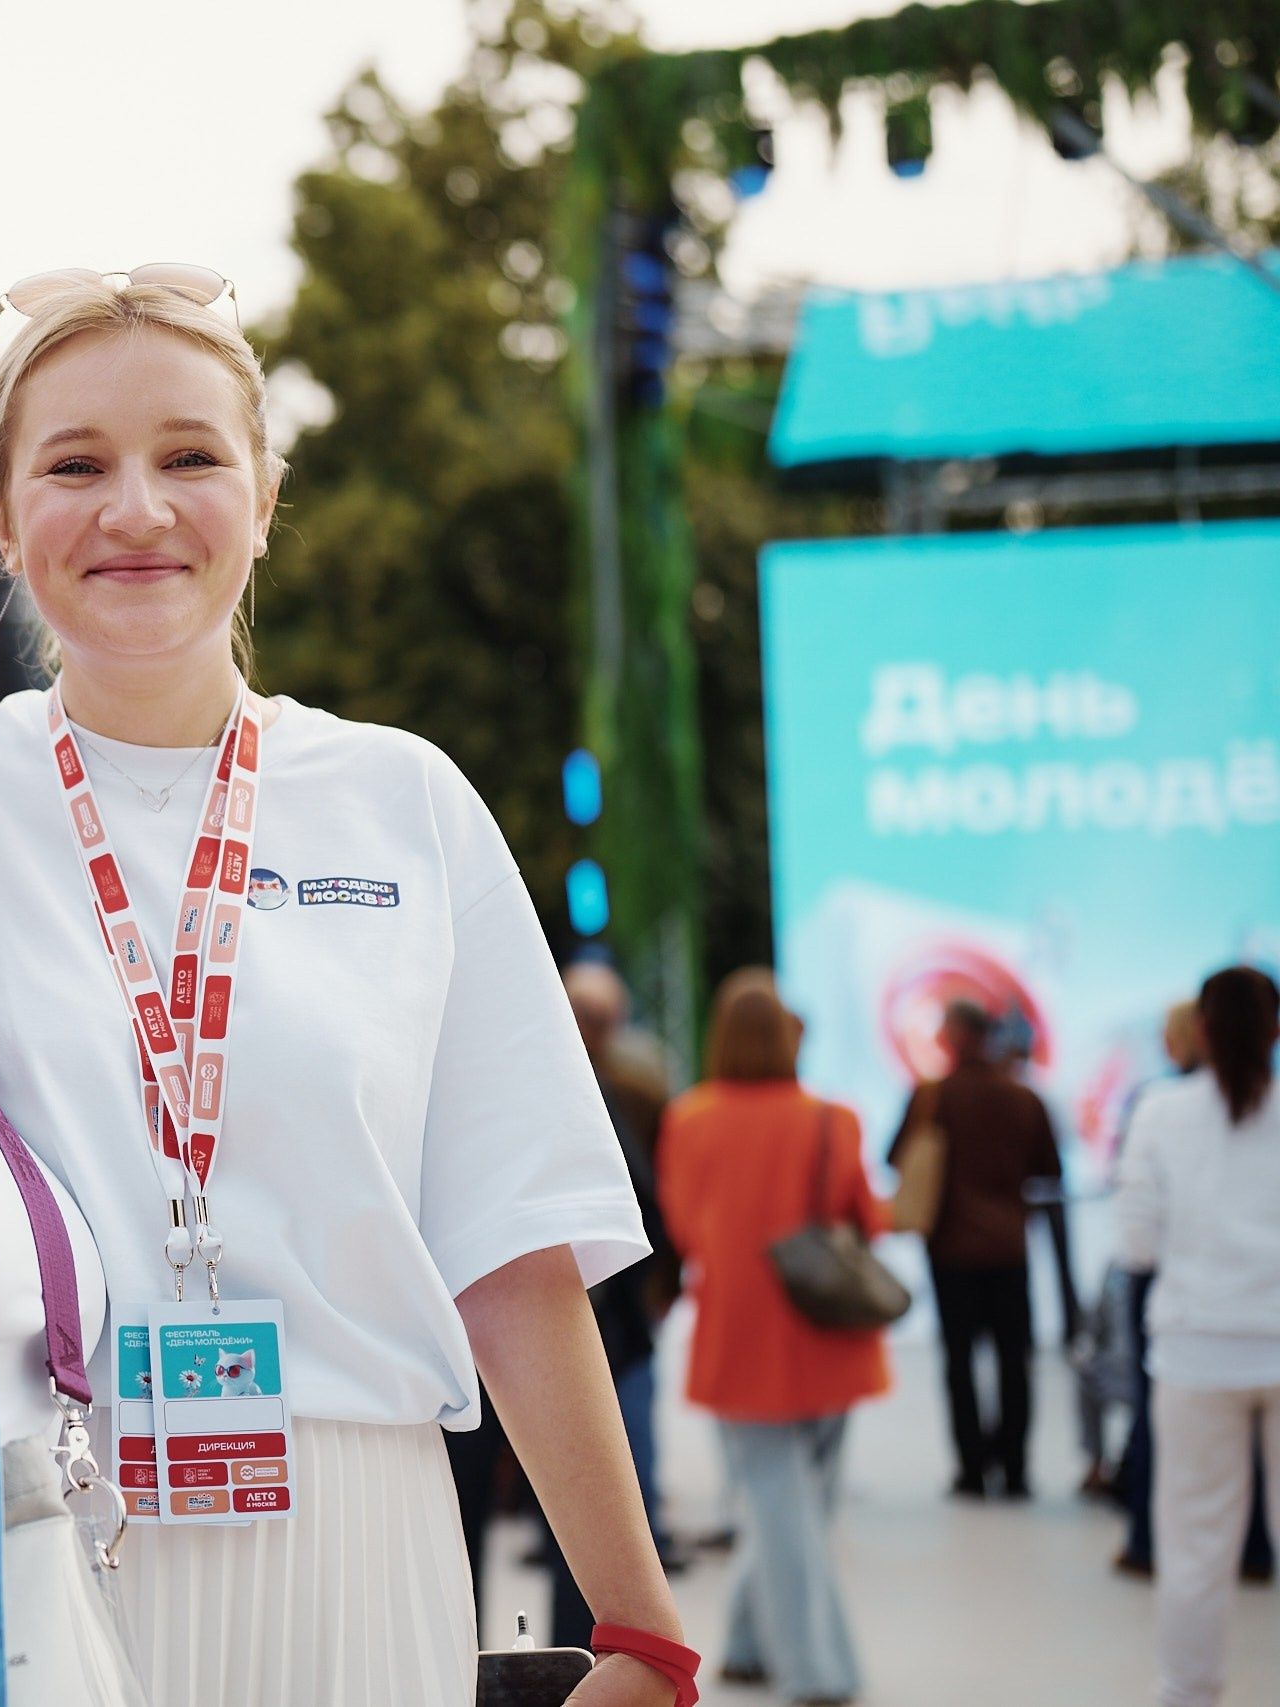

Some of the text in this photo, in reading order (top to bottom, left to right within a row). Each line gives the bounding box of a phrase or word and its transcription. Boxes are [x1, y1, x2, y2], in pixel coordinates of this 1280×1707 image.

[861, 662, 1140, 758] День
[231, 853, 243, 882] ЛЕТО
[303, 890, 396, 905] МОСКВЫ
[176, 970, 187, 1003] ЛЕТО
[144, 1007, 162, 1039] ЛЕТО
[195, 1150, 207, 1176] ЛЕТ
[165, 1330, 220, 1338] ФЕСТИВАЛЬ
[166, 1339, 194, 1347] «ДЕНЬ
[197, 1441, 256, 1453] ДИРЕКЦИЯ
[246, 1491, 277, 1502] ЛЕТО
